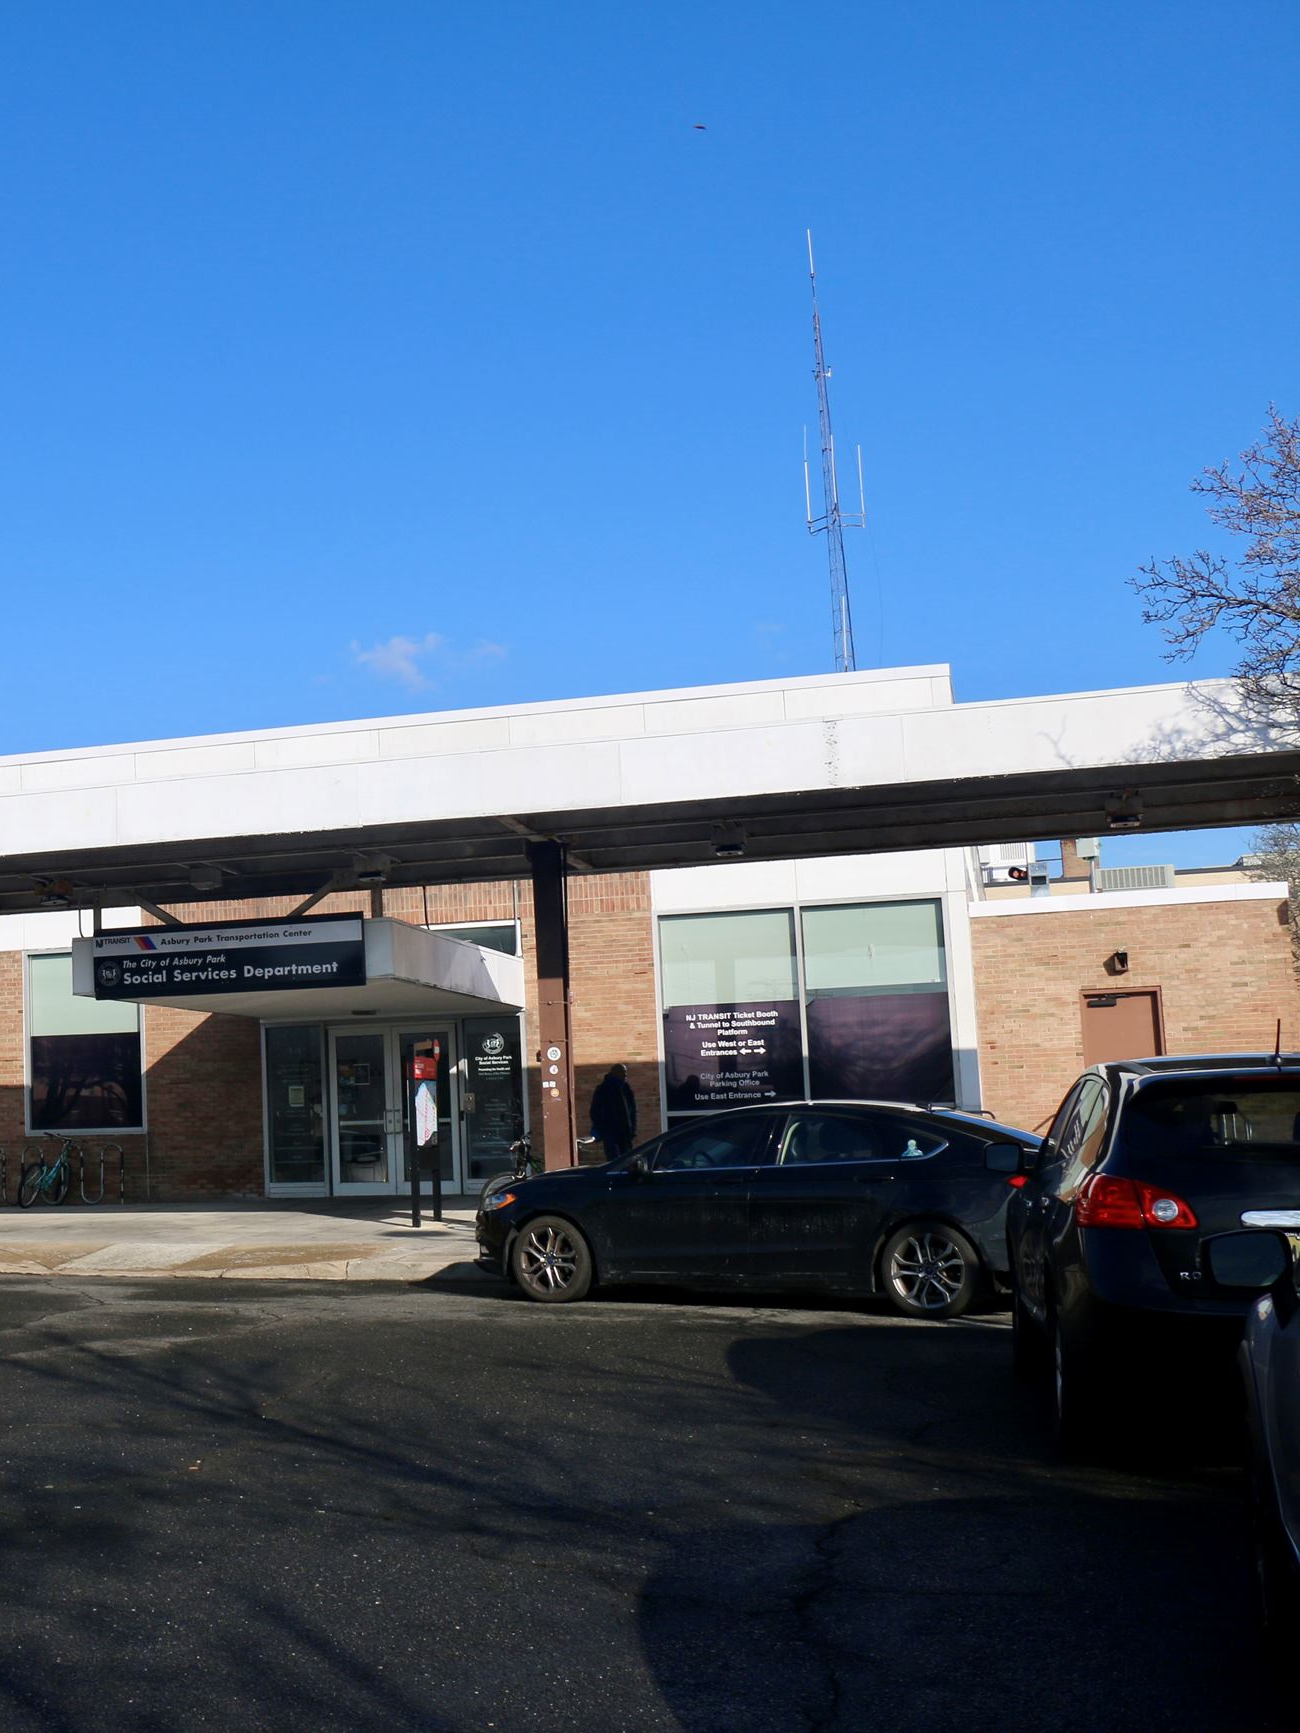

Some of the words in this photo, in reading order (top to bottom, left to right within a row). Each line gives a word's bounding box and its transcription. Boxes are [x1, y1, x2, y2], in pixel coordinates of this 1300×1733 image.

[104, 937, 131, 946] TRANSIT
[160, 937, 190, 947] Asbury
[193, 935, 213, 944] Park
[216, 931, 280, 942] Transportation
[282, 929, 312, 938] Center
[122, 960, 137, 968] The
[140, 959, 157, 969] City
[160, 957, 170, 966] of
[172, 957, 203, 966] Asbury
[206, 954, 226, 963] Park
[123, 970, 167, 984] Social
[173, 967, 237, 982] Services
[243, 961, 338, 980] Department
[697, 1012, 732, 1021] TRANSIT
[733, 1011, 755, 1019] Ticket
[756, 1010, 779, 1018] Booth
[689, 1022, 696, 1030] &
[696, 1021, 721, 1029] Tunnel
[731, 1018, 776, 1027] Southbound
[717, 1028, 748, 1036] Platform
[700, 1049, 738, 1057] Entrances
[700, 1072, 715, 1081] City
[716, 1071, 725, 1079] of
[725, 1071, 751, 1079] Asbury
[709, 1080, 738, 1088] Parking
[739, 1079, 760, 1087] Office
[694, 1093, 709, 1101] Use
[710, 1092, 727, 1100] East
[728, 1091, 762, 1100] Entrance
